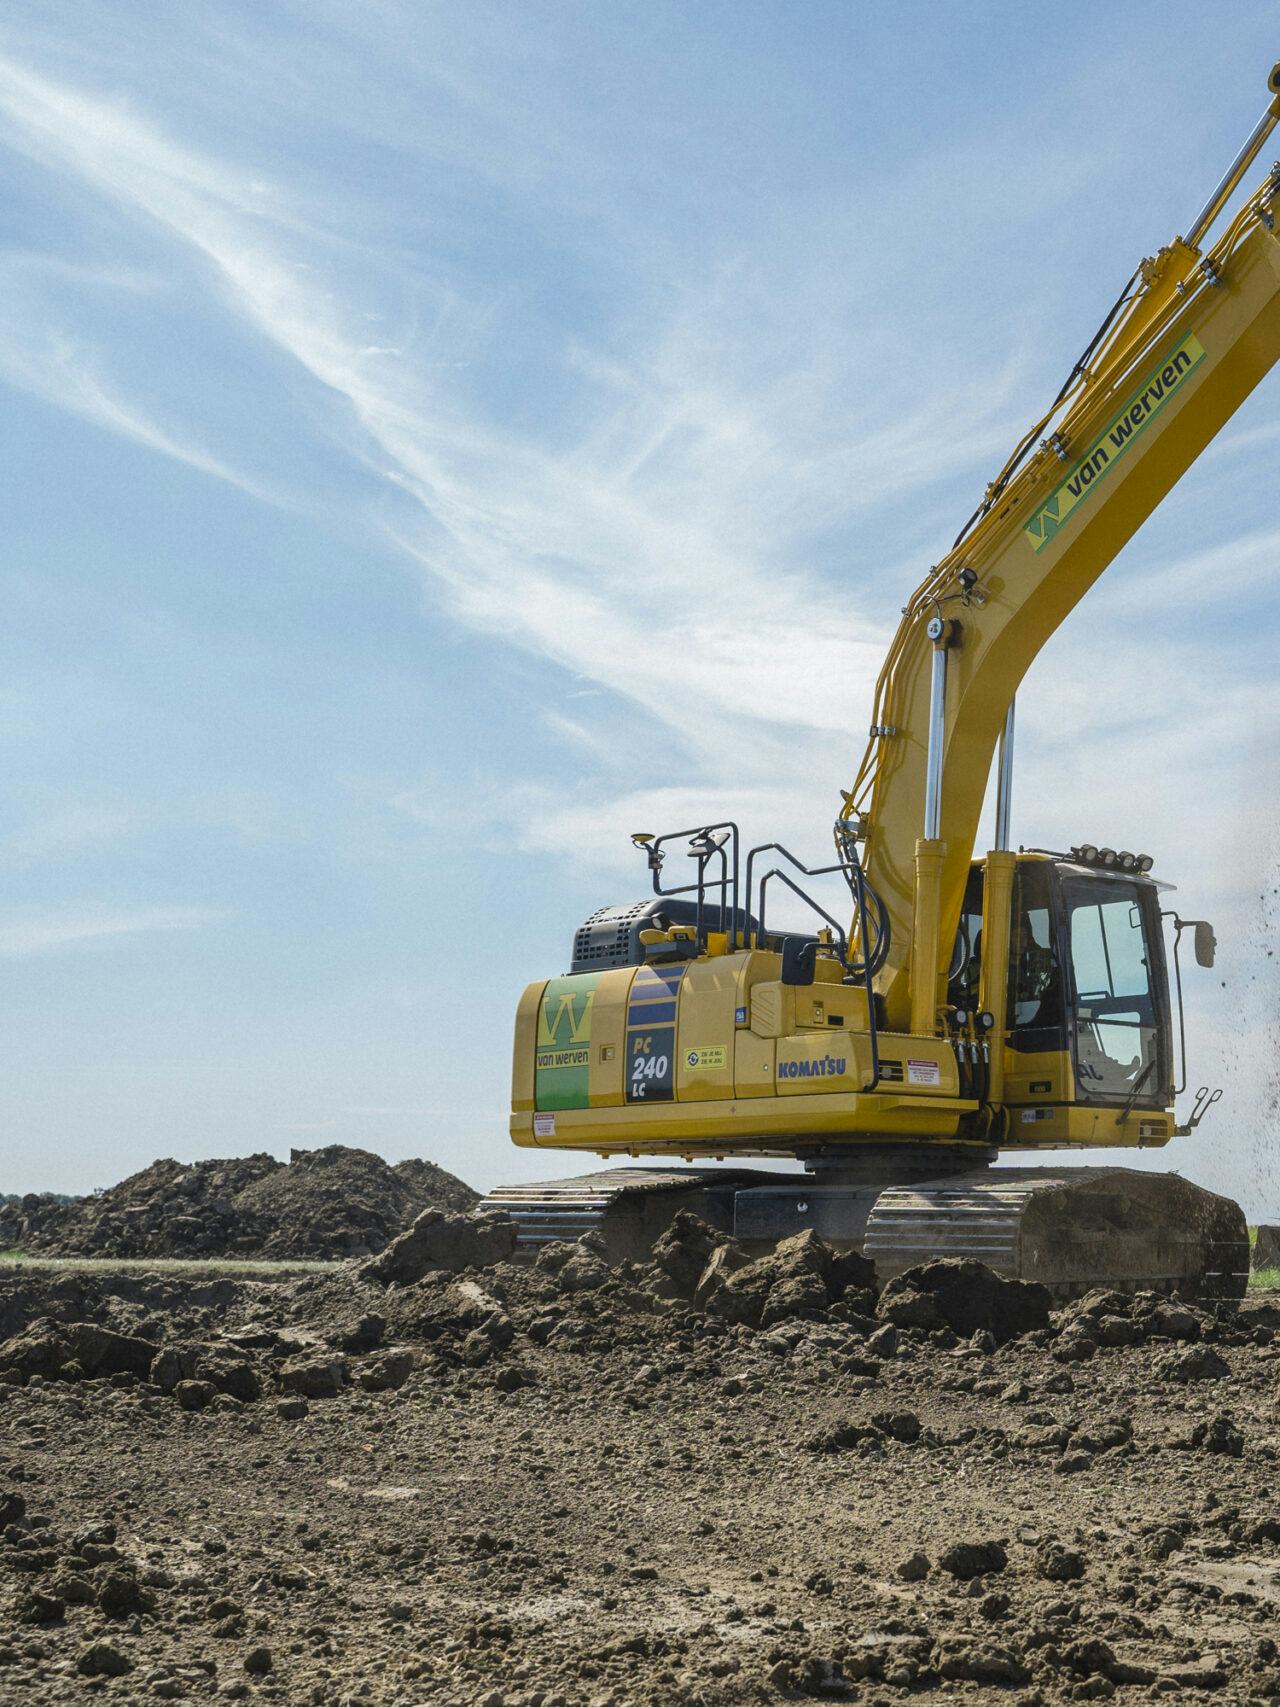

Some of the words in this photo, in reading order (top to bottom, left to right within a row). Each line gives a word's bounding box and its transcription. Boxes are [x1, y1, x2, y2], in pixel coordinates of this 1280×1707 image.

[1066, 447, 1110, 497] van
[1109, 350, 1192, 448] werven
[633, 1037, 652, 1054] PC
[538, 1054, 554, 1067] van
[555, 1051, 589, 1065] werven
[632, 1055, 668, 1080] 240
[778, 1055, 846, 1078] KOMATSU
[632, 1083, 646, 1097] LC
